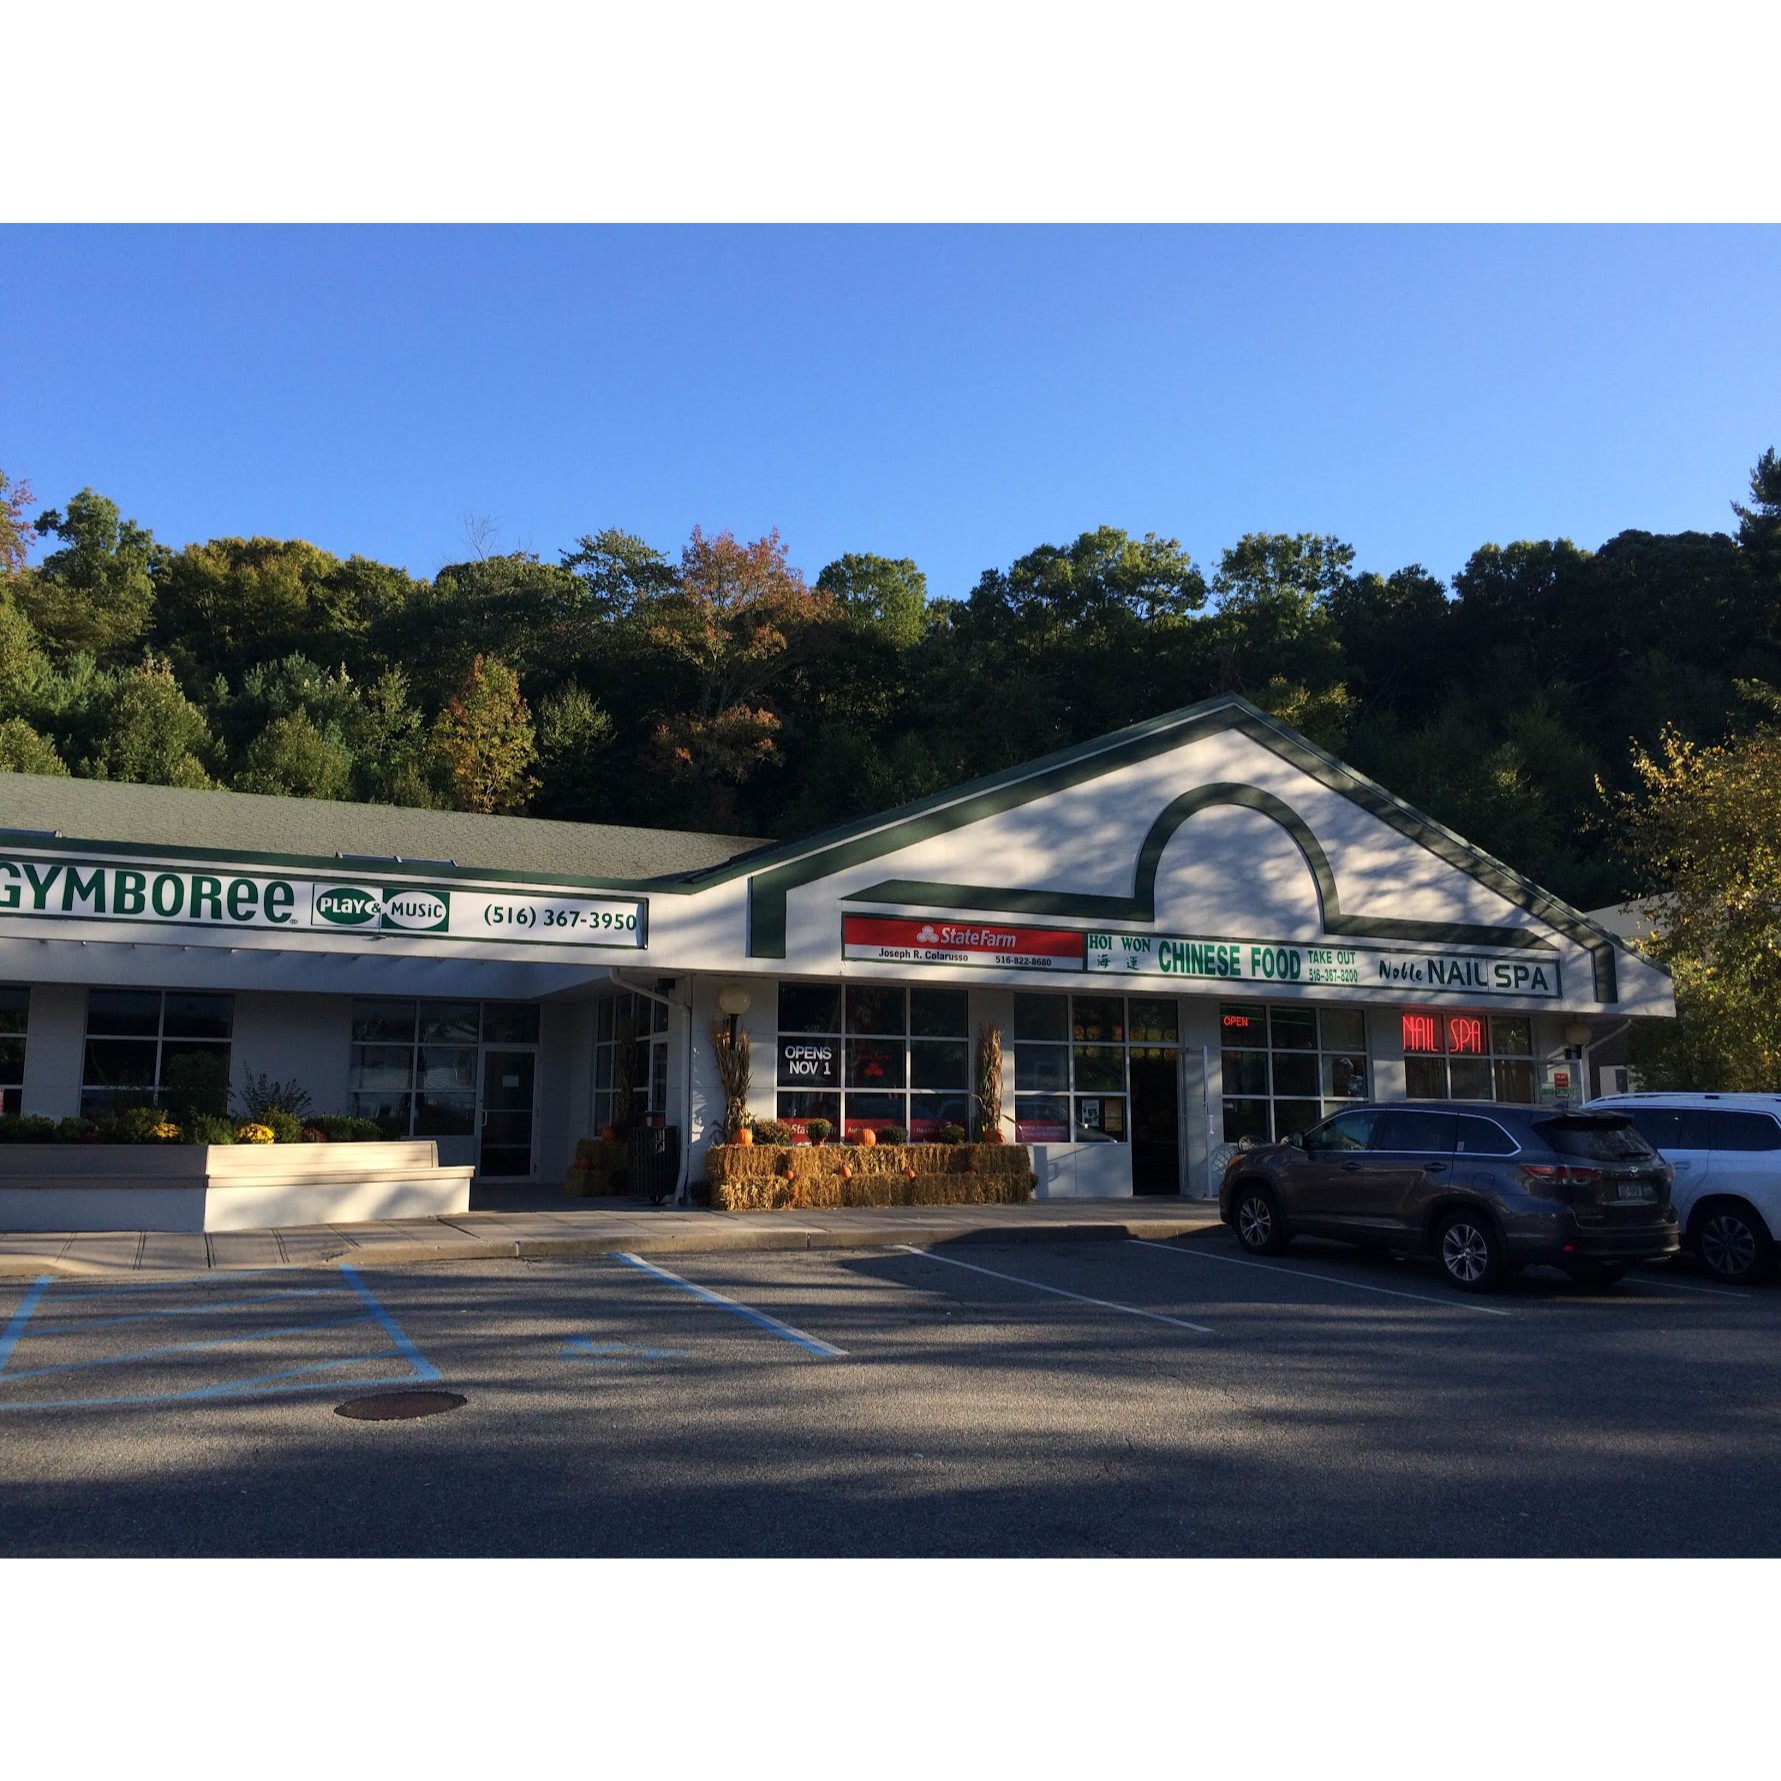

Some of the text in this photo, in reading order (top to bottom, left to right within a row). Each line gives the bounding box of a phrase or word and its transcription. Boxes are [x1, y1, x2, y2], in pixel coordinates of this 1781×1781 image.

[484, 903, 637, 931] (516) 367-3950
[1089, 935, 1151, 952] HOI WON
[878, 947, 969, 962] Joseph R. Colarusso
[995, 956, 1052, 967] 516-822-8680
[1158, 940, 1301, 980] CHINESE FOOD
[1308, 950, 1356, 965] TAKE OUT
[1309, 968, 1358, 982] 516-367-8200
[1379, 959, 1549, 991] Noble NAIL SPA
[1223, 1016, 1249, 1027] OPEN
[1402, 1016, 1481, 1053] NAIL SPA
[785, 1045, 832, 1060] OPENS
[789, 1061, 831, 1075] NOV 1
